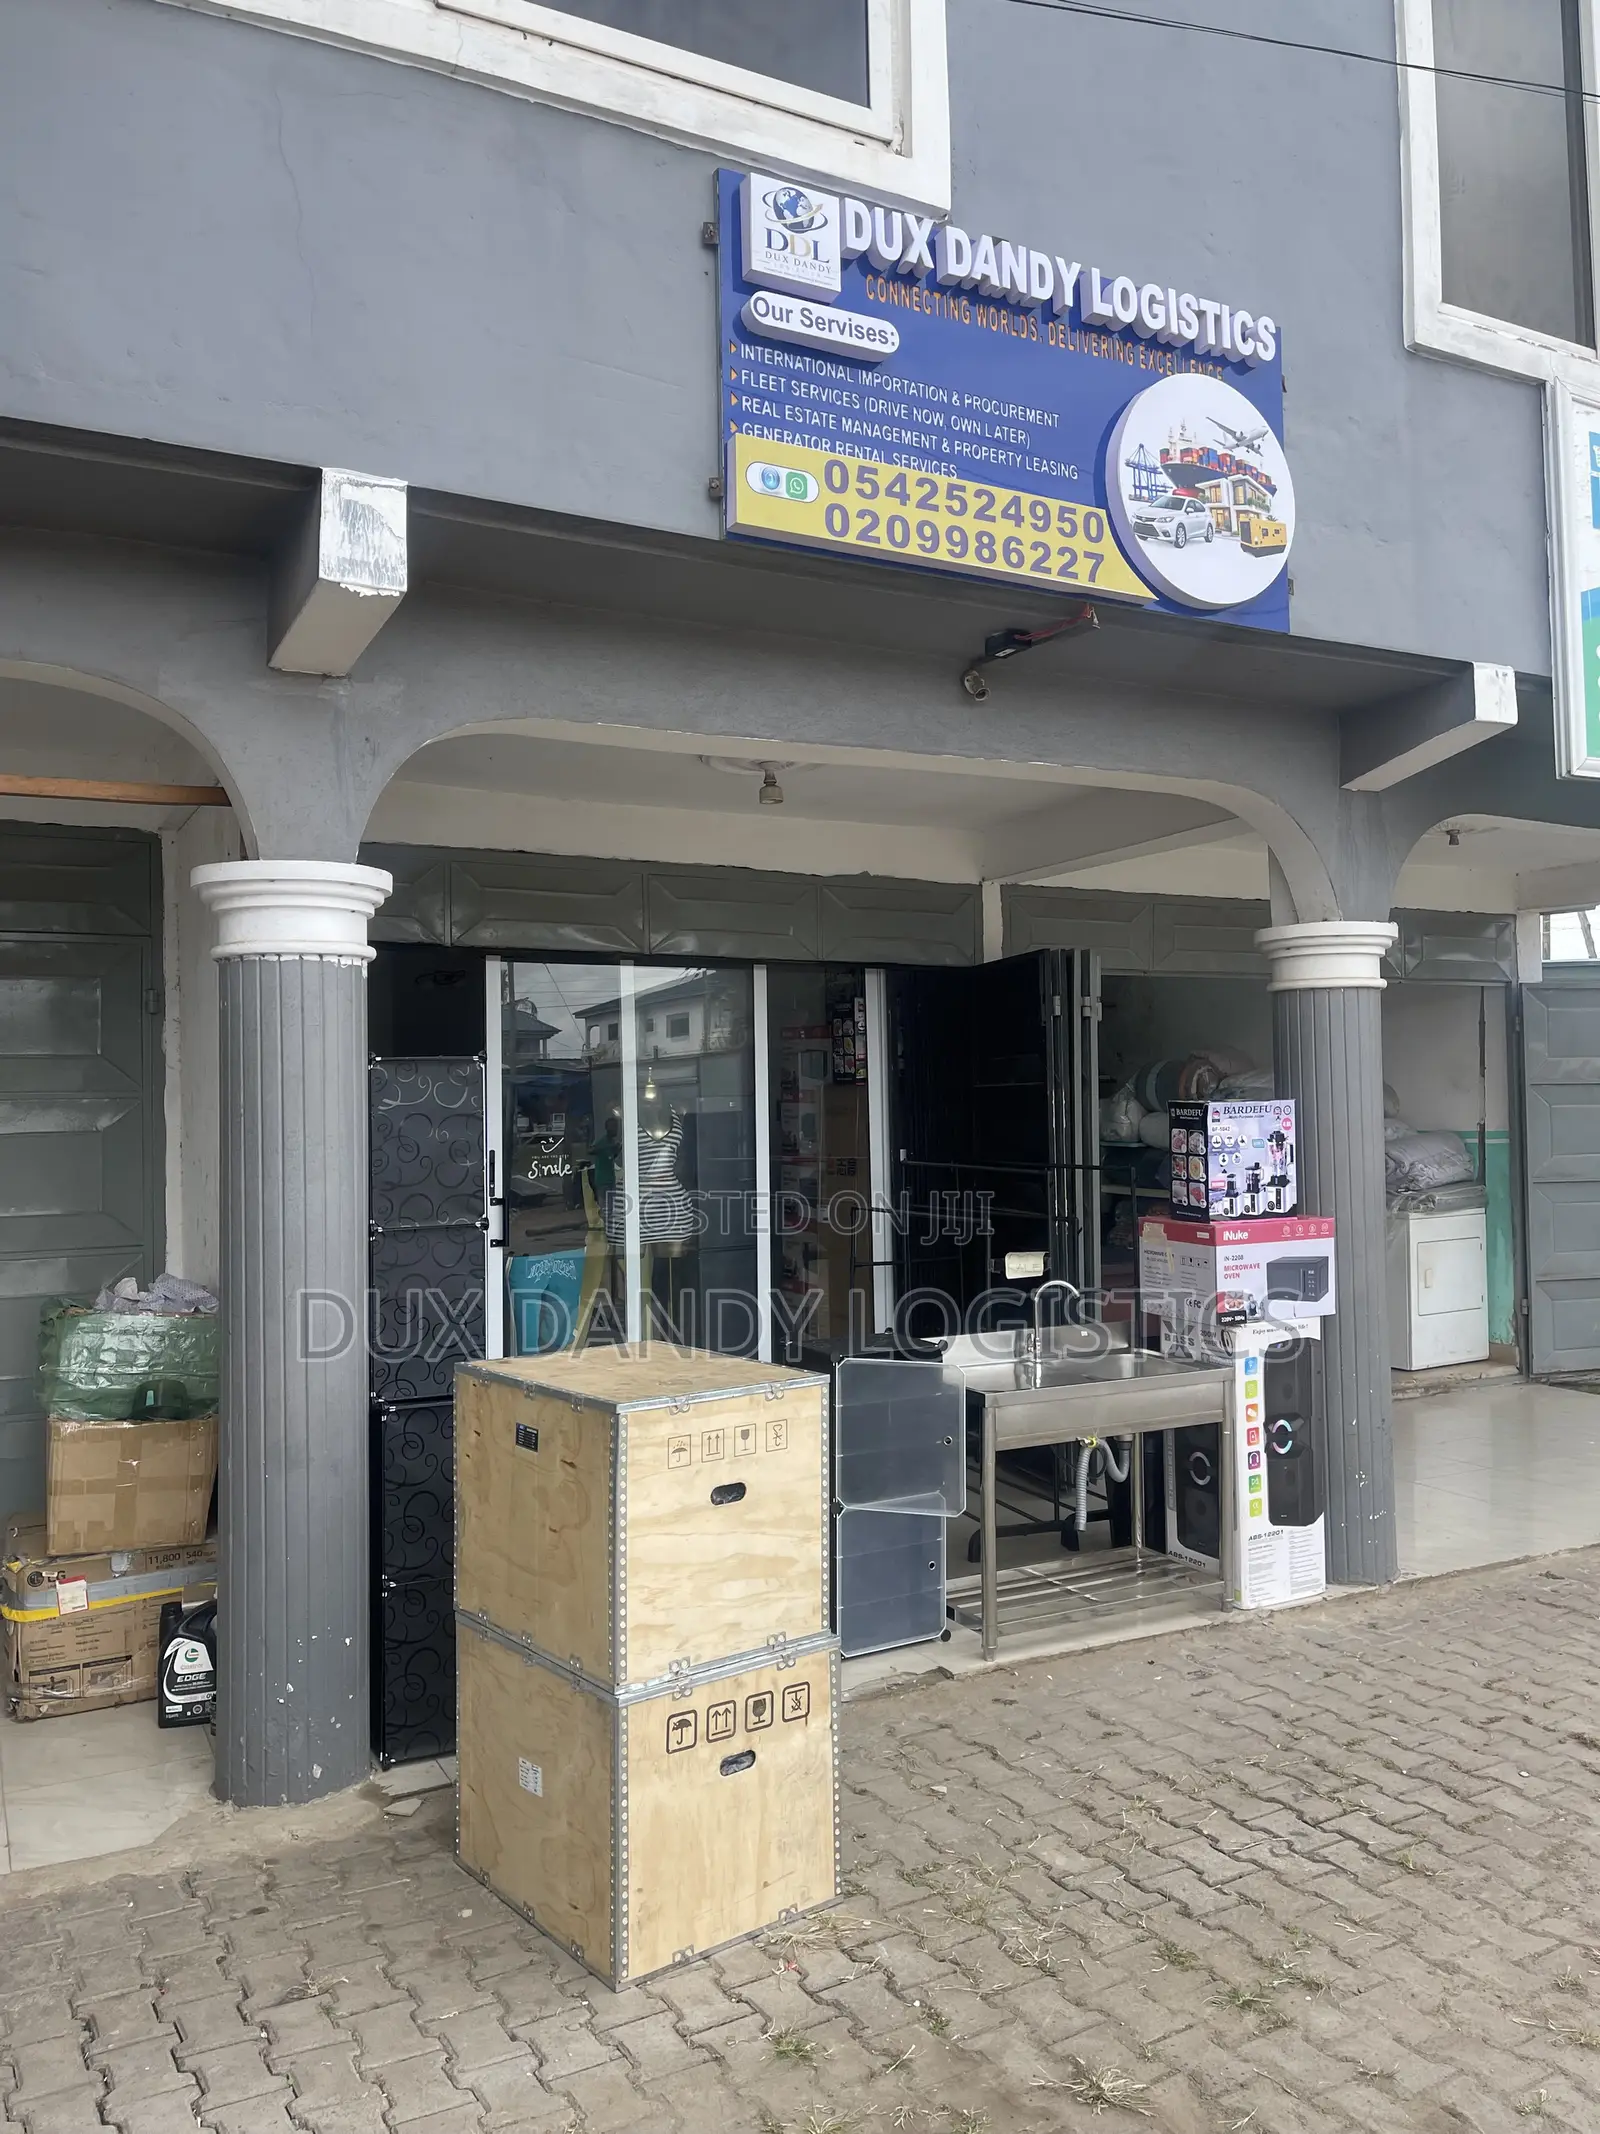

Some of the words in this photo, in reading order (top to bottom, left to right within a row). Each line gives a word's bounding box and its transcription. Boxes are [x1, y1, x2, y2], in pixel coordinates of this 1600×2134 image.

[764, 227, 830, 263] DDL
[765, 250, 789, 264] DUX
[794, 258, 832, 274] DANDY
[845, 197, 934, 269] DUX
[946, 225, 1082, 309] DANDY
[1091, 267, 1276, 362] LOGISTICS
[753, 296, 794, 324] Our
[799, 307, 896, 347] Servises:
[865, 274, 972, 325] CONNECTING
[1048, 320, 1135, 366] DELIVERING
[740, 343, 855, 383] INTERNATIONAL
[858, 369, 948, 403] IMPORTATION
[951, 390, 961, 406] &
[964, 393, 1060, 428] PROCUREMENT
[741, 369, 787, 393] FLEET
[791, 379, 860, 410] SERVICES
[864, 396, 909, 420] (DRIVE
[913, 405, 947, 431] NOW,
[950, 414, 981, 436] OWN
[985, 423, 1031, 449] LATER)
[742, 395, 781, 419] REAL
[785, 404, 837, 430] ESTATE
[841, 416, 938, 450] MANAGEMENT
[941, 437, 950, 453] &
[954, 440, 1022, 468] PROPERTY
[1025, 455, 1079, 480] LEASING
[742, 422, 831, 452] GENERATOR
[835, 441, 886, 464] RENTAL
[892, 452, 958, 479] SERVICES
[824, 459, 1105, 544] 0542524950
[824, 503, 1105, 583] 0209986227
[1223, 1104, 1273, 1115] BARDEFU
[1223, 1230, 1249, 1241] iNuke
[1223, 1262, 1261, 1272] MICROWAVE
[1223, 1272, 1241, 1280] OVEN
[1164, 1332, 1195, 1346] BASS
[148, 1553, 181, 1564] 11,800
[186, 1550, 203, 1559] 540
[176, 1673, 207, 1683] EDGE
